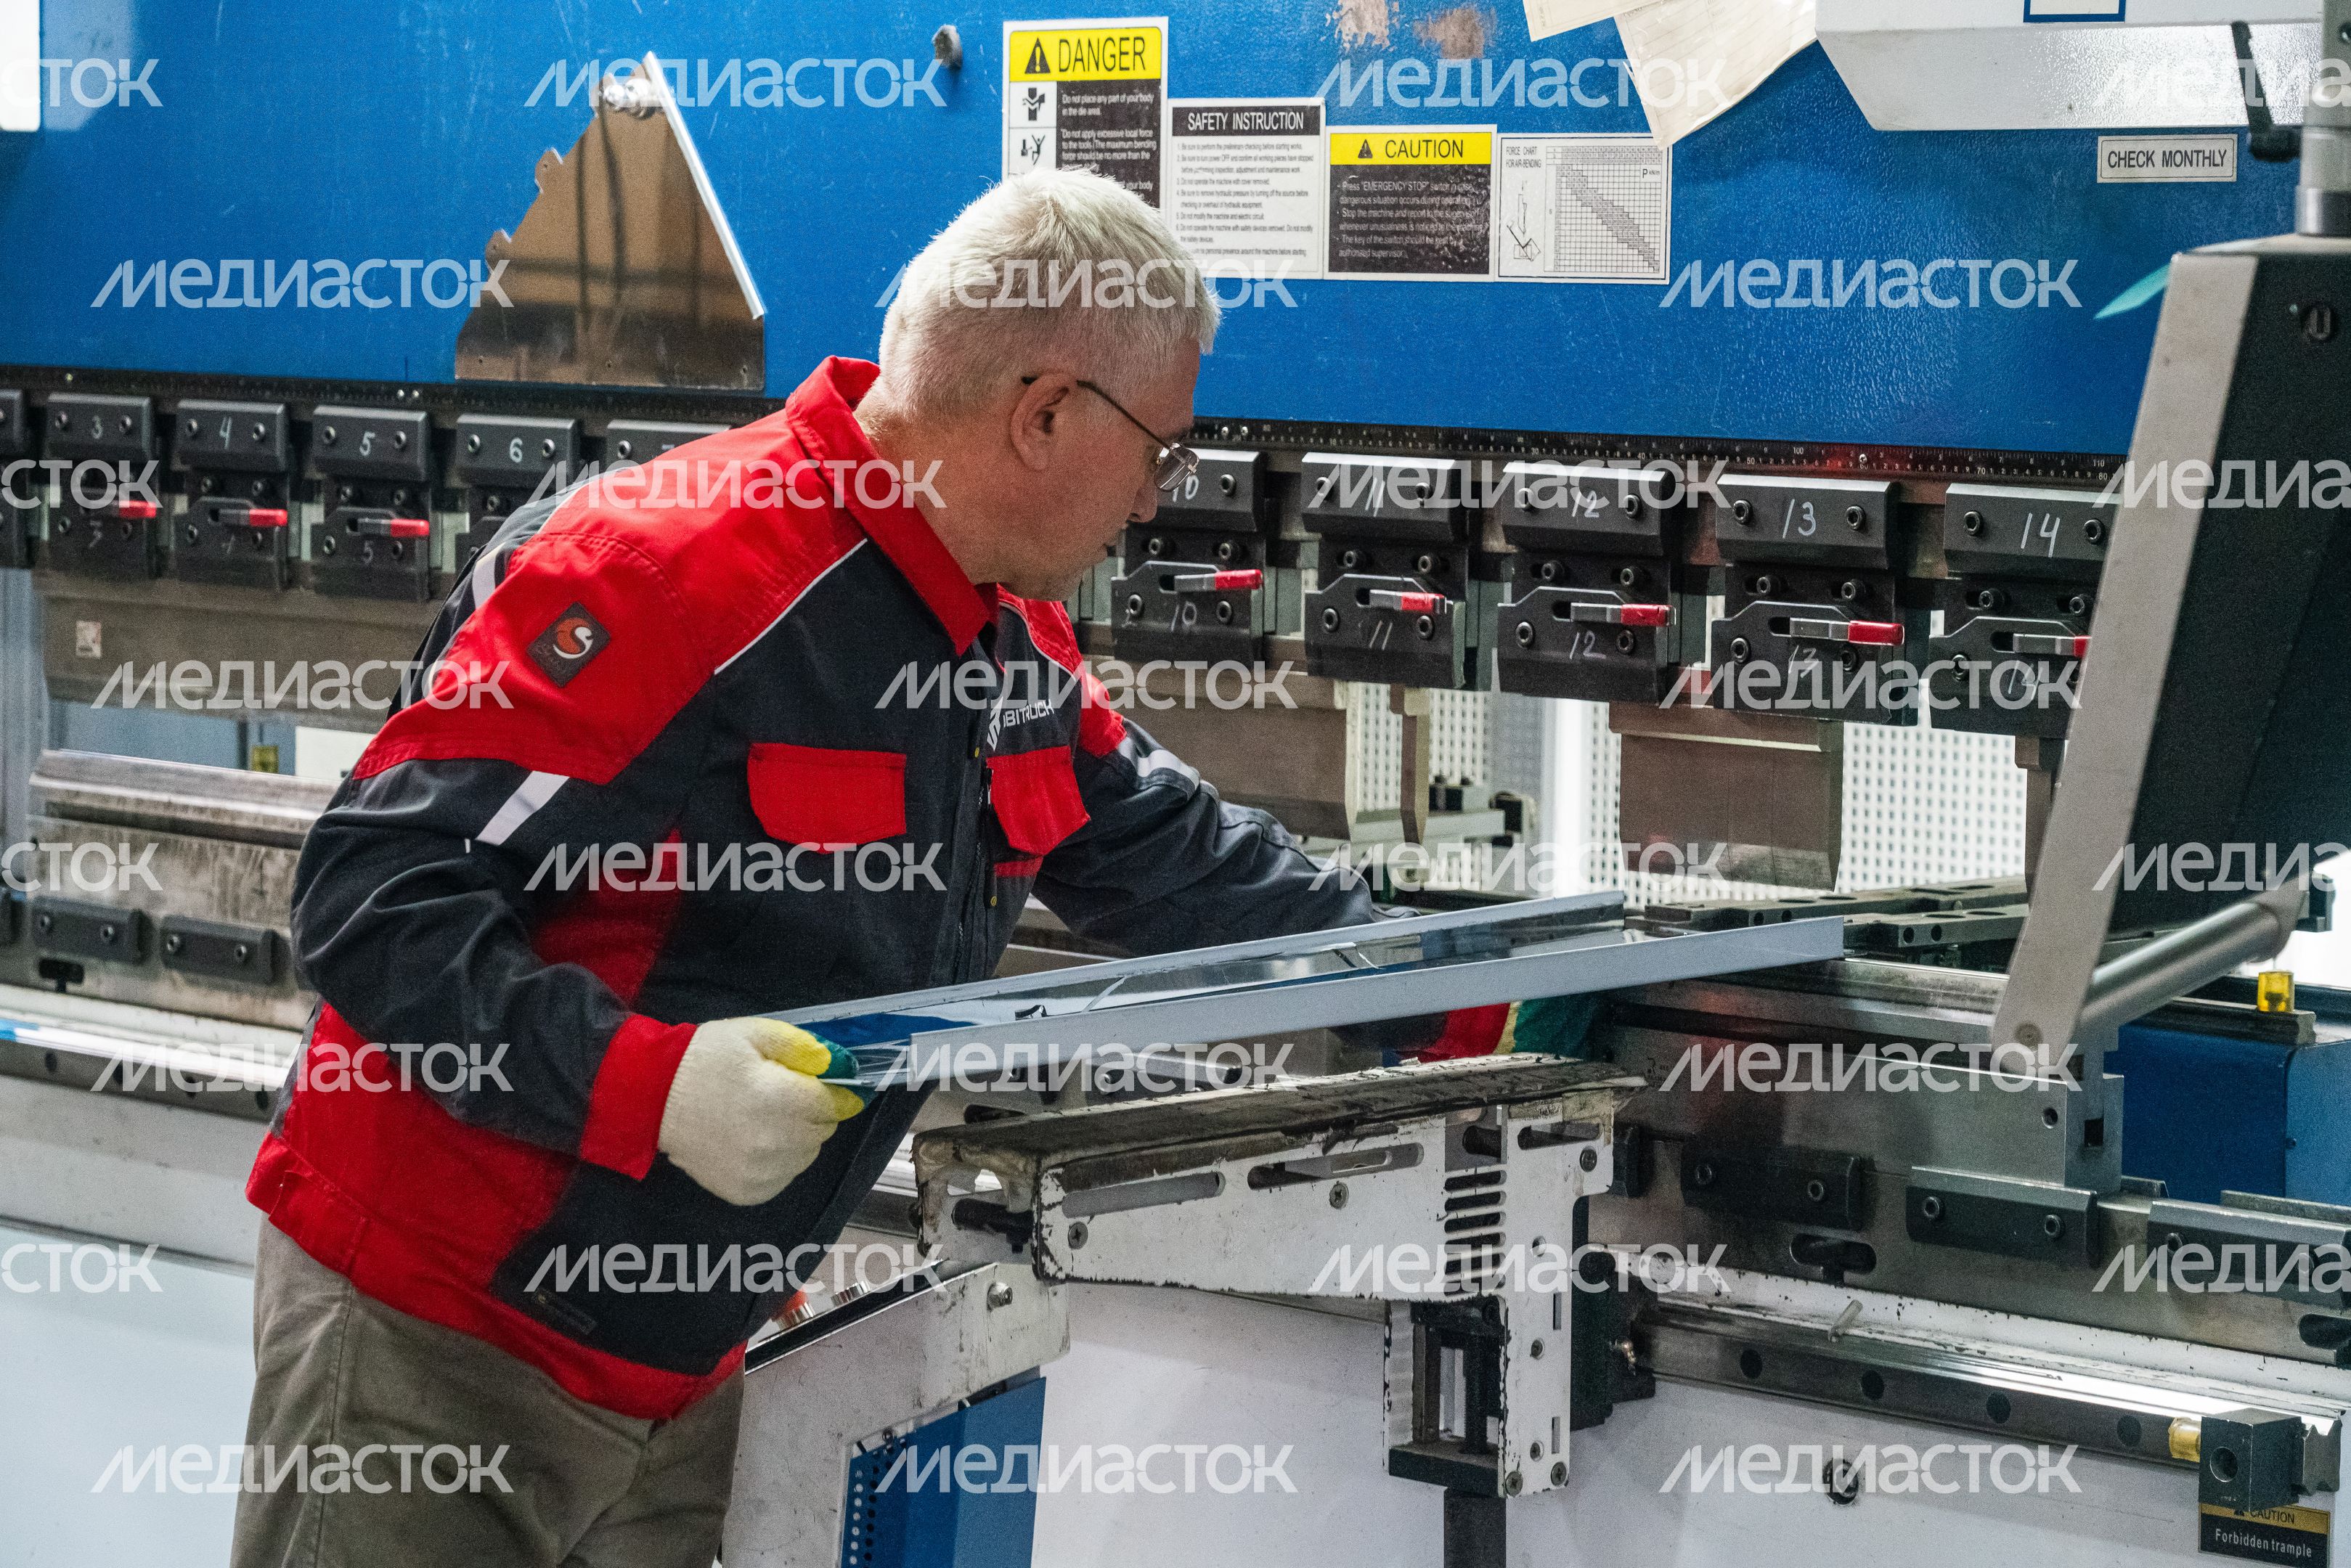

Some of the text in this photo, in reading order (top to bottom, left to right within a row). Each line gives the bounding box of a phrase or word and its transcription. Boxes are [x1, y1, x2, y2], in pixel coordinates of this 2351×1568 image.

[1059, 36, 1146, 72] DANGER
[1188, 112, 1304, 131] SAFETY INSTRUCTION
[1385, 139, 1464, 158] CAUTION
[1506, 147, 1520, 155] FORCE
[1523, 147, 1537, 155] CHART
[2108, 149, 2227, 168] CHECK MONTHLY
[1642, 168, 1648, 179] P
[91, 416, 103, 439] 3
[219, 417, 232, 449] 4
[359, 431, 375, 456] 5
[509, 438, 523, 462] 6
[1572, 489, 1600, 518] 12
[1782, 499, 1816, 539] 13
[2021, 513, 2060, 558] 14
[1170, 601, 1197, 632] 10
[1570, 631, 1606, 659] 12
[1788, 645, 1818, 678] 13
[2008, 660, 2042, 701] 14
[2251, 1510, 2294, 1524] CAUTION
[2215, 1528, 2312, 1559] Forbidden trample
